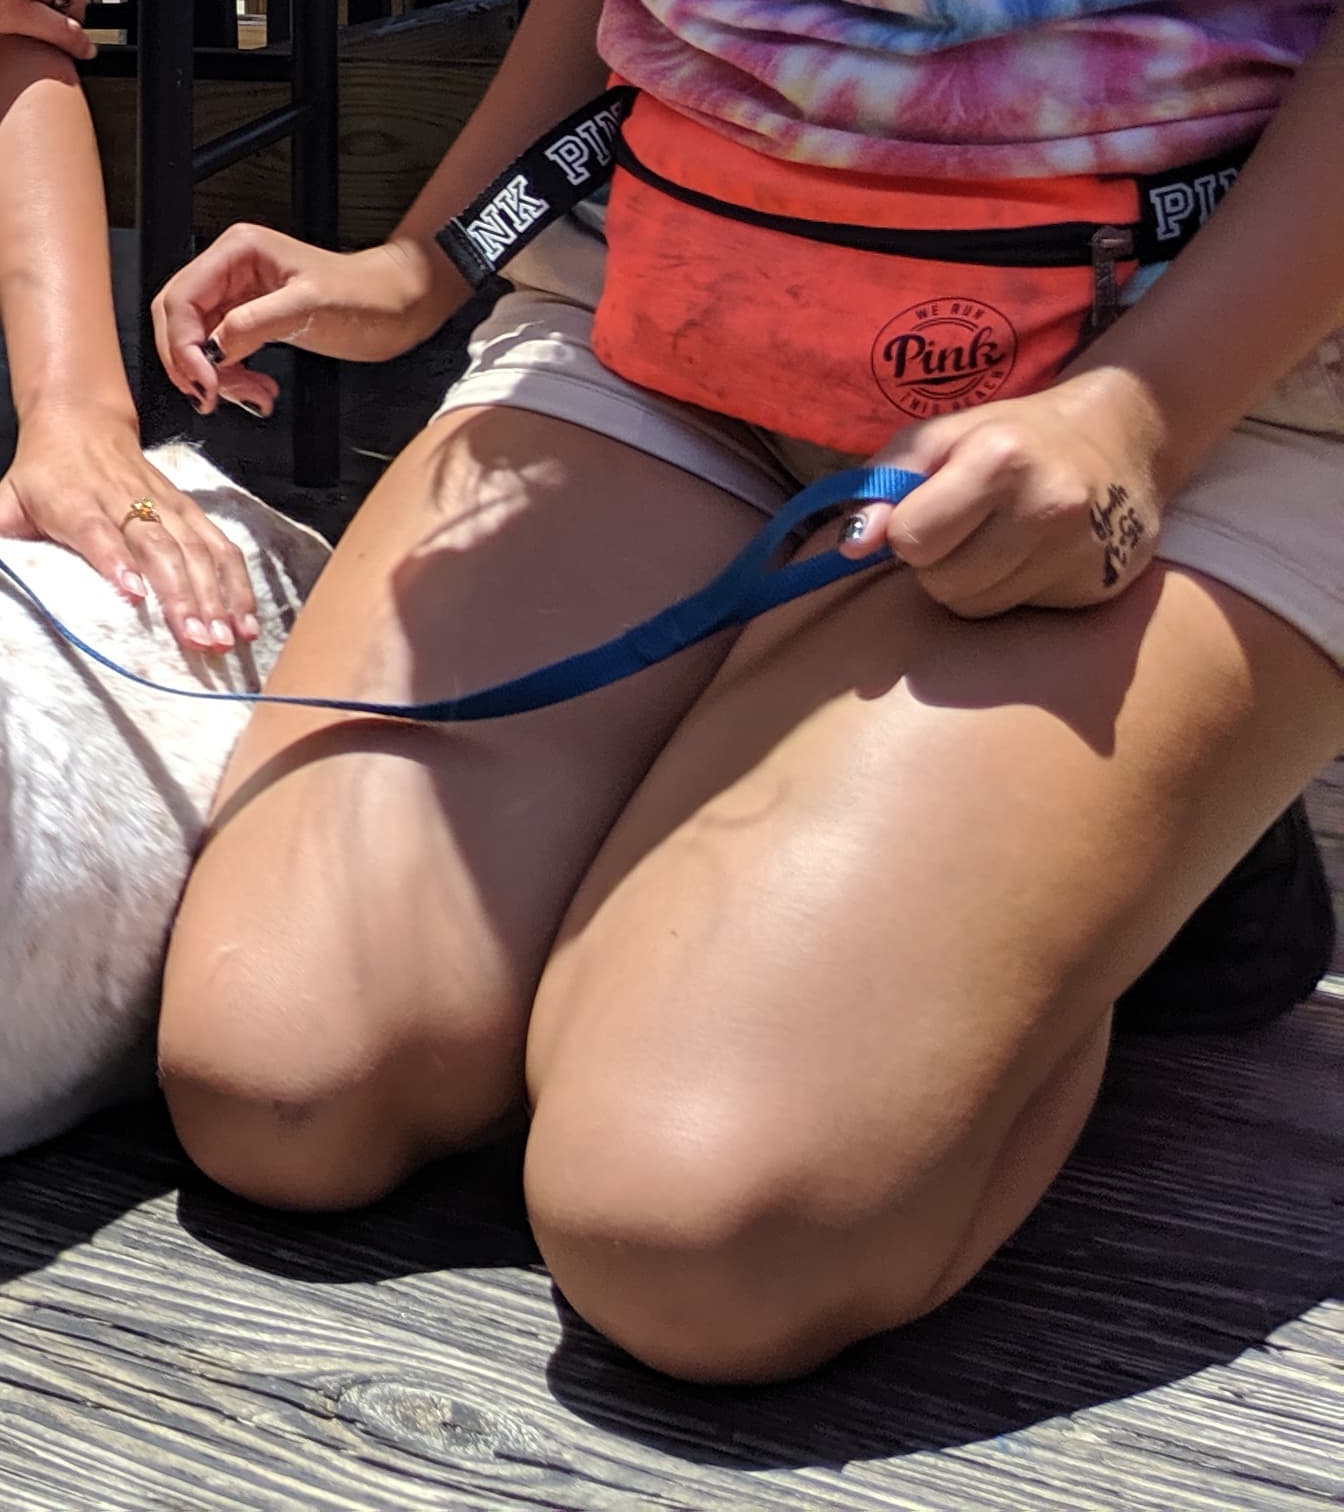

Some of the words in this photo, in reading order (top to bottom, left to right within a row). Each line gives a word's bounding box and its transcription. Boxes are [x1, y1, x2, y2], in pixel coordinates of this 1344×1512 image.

[915, 304, 940, 320] WE
[950, 302, 986, 320] RUN
[882, 325, 1006, 378] Pink
